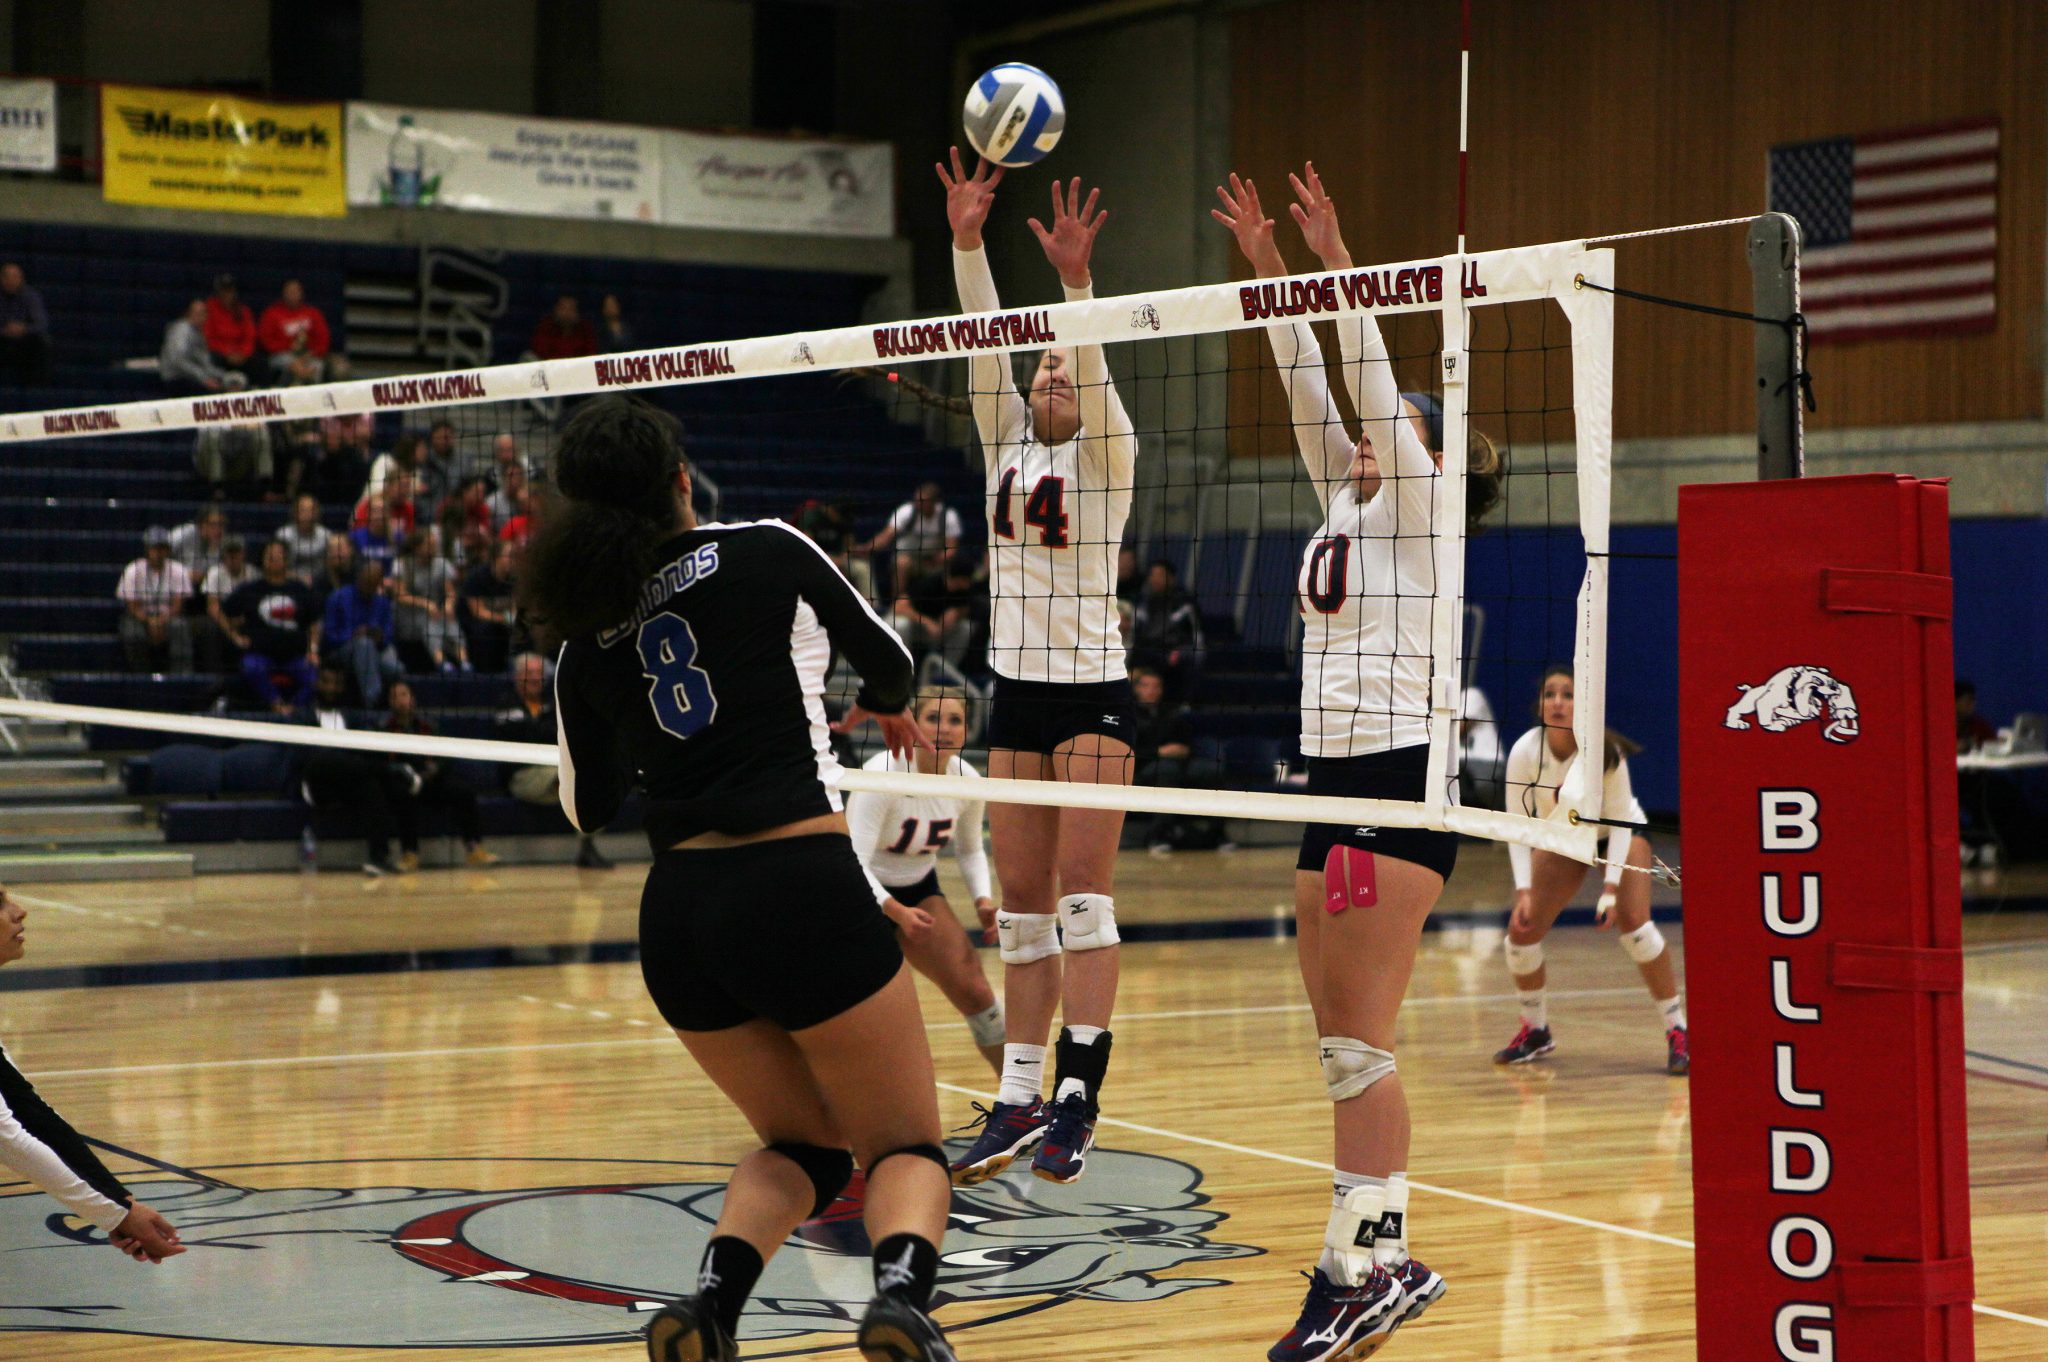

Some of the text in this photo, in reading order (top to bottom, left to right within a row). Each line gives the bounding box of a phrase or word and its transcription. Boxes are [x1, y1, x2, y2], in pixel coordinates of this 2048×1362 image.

[143, 110, 329, 148] MasterPark
[1239, 260, 1487, 321] BULLDOG VOLLEYBLL
[873, 310, 1055, 358] BULLDOG VOLLEYBALL
[372, 373, 486, 406] BULLDOG VOLLEYBALL
[594, 347, 735, 386] BULLDOG VOLLEYBALL
[993, 466, 1069, 549] 14
[636, 611, 718, 740] 8
[886, 817, 953, 855] 15
[1758, 787, 1838, 1362] BULLDOG
